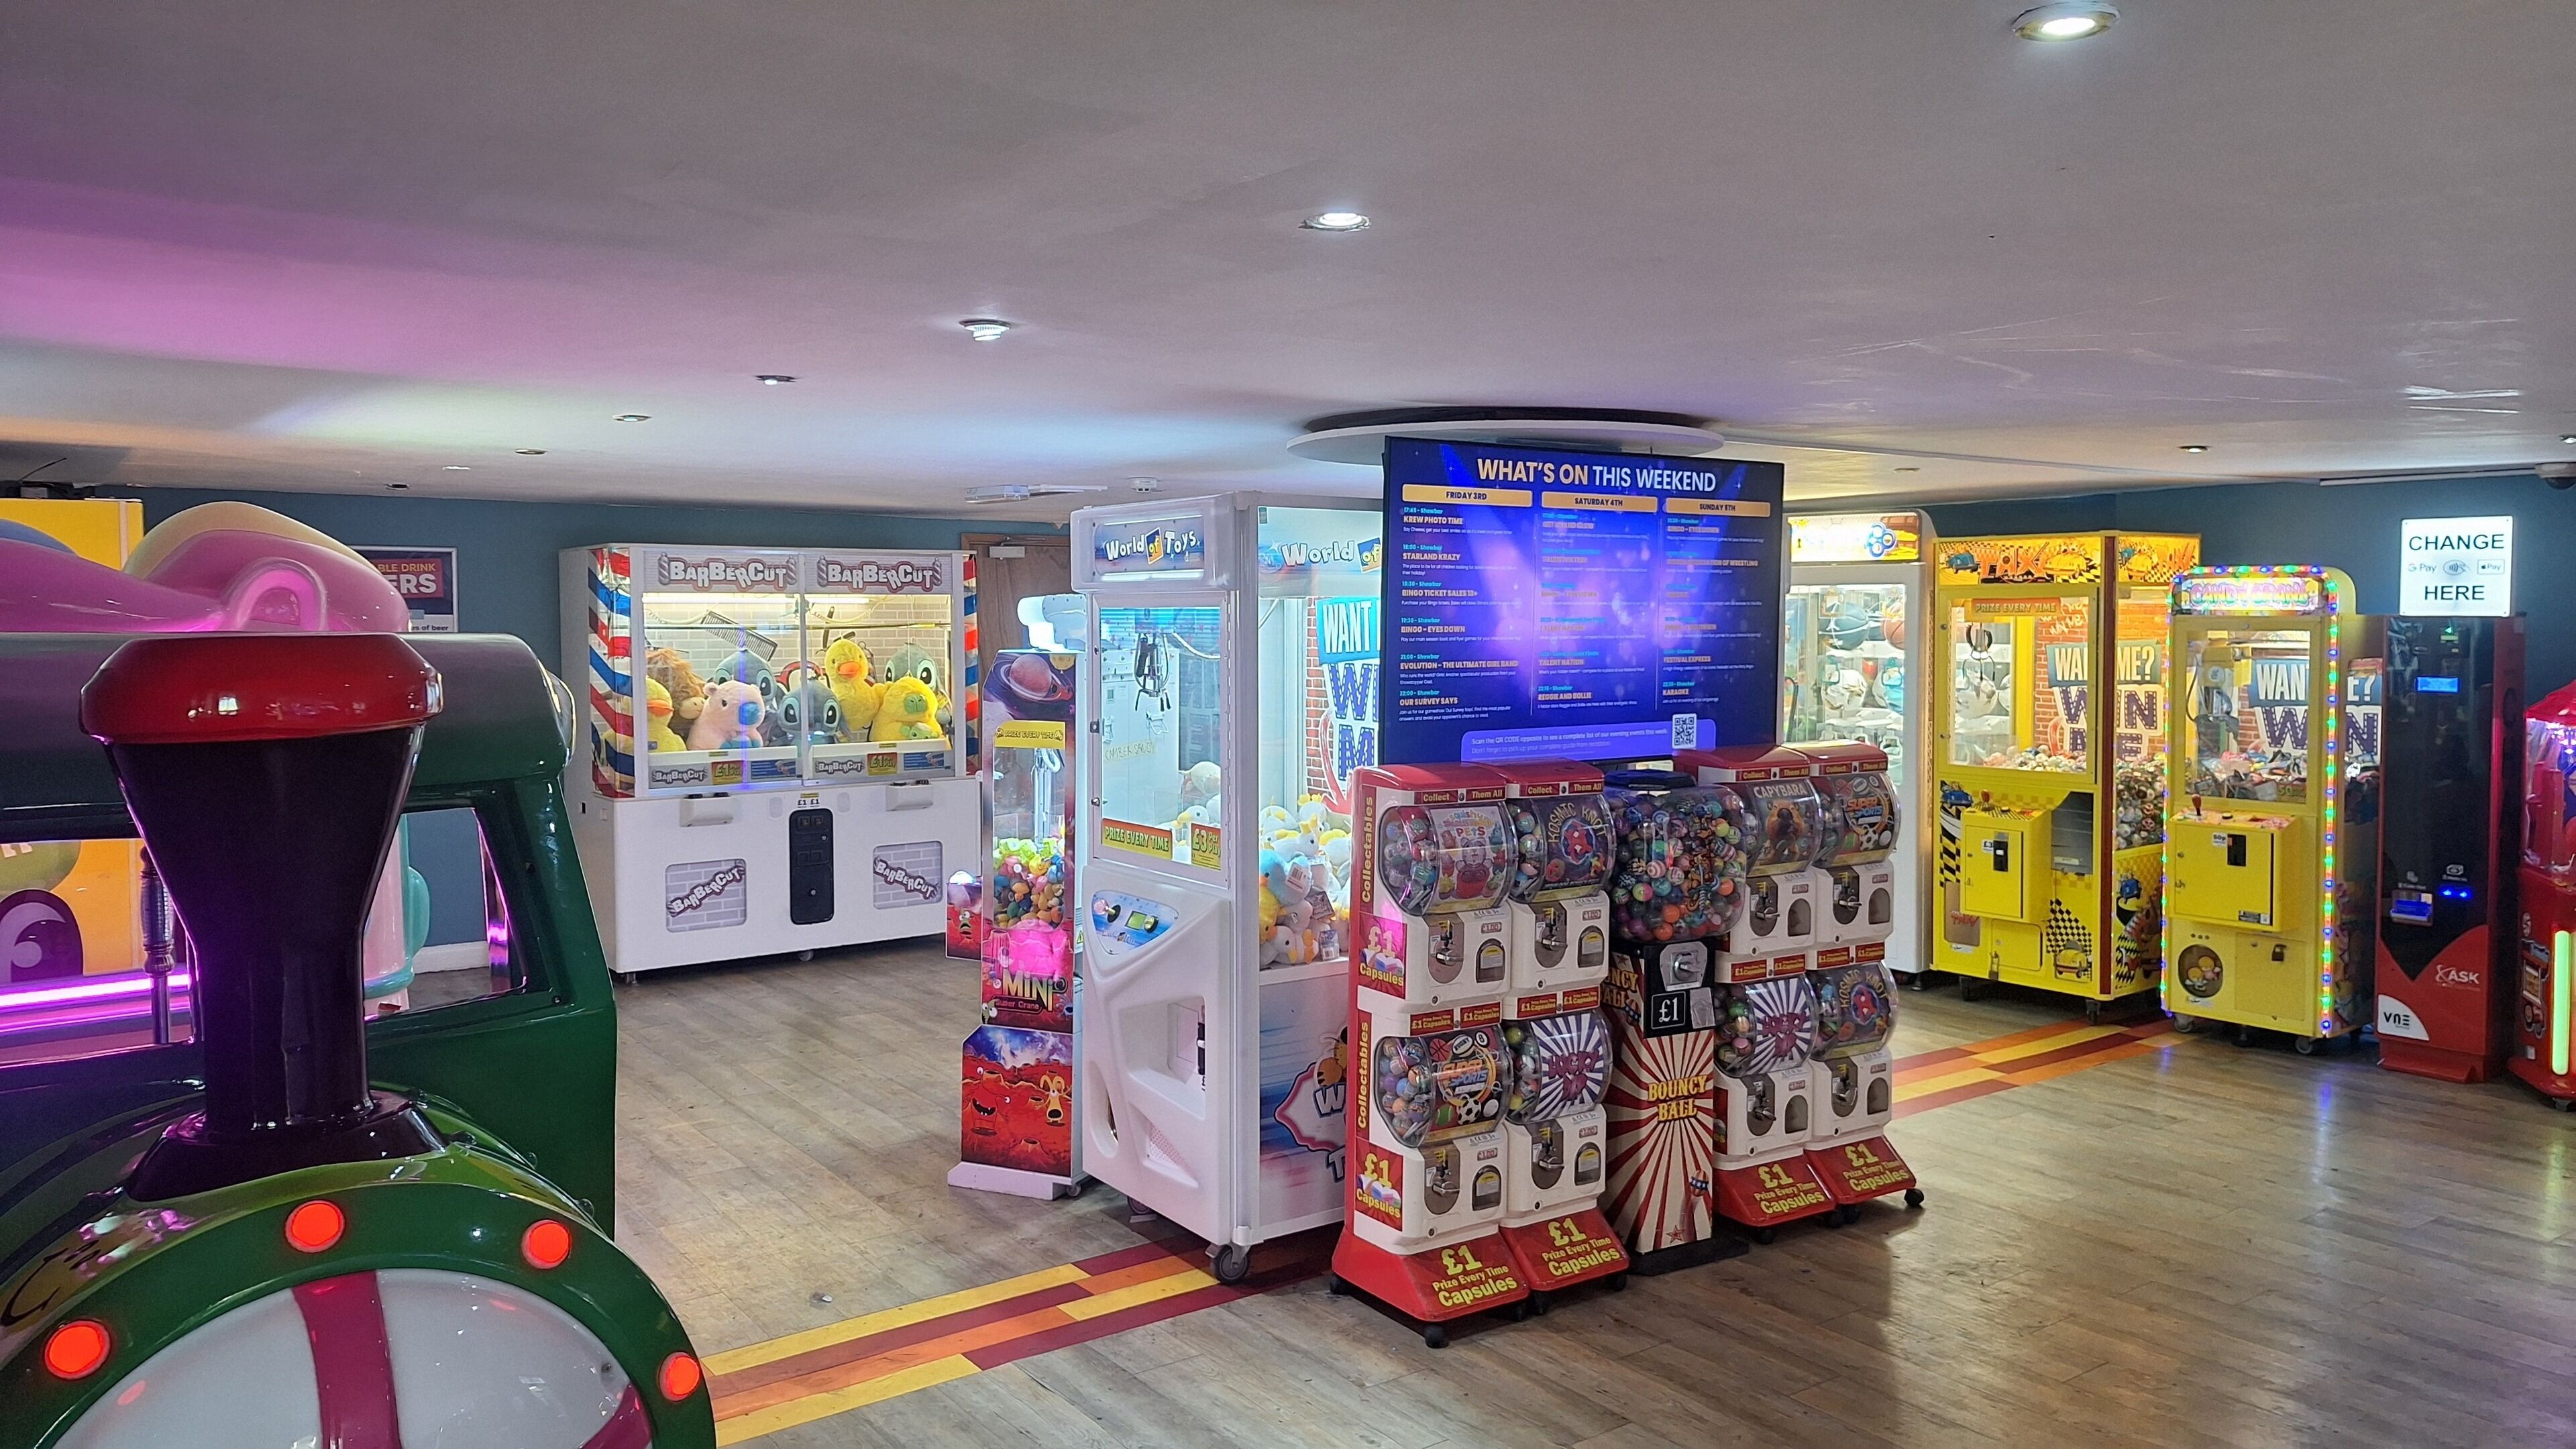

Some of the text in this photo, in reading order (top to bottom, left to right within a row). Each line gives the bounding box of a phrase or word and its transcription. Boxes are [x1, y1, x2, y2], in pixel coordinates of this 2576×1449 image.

[1477, 458, 1716, 492] WHAT'S ON THIS WEEKEND
[1446, 491, 1488, 501] FRIDAY 3RD
[1574, 498, 1623, 506] SATURDAY 4TH
[1699, 503, 1723, 511] SUNDAY
[1106, 530, 1197, 561] World of Toys
[1280, 540, 1355, 567] World
[2409, 534, 2504, 551] CHANGE
[401, 563, 436, 572] DRINK
[2420, 563, 2437, 574] Pay
[2487, 563, 2502, 571] Pay
[2424, 585, 2485, 600] HERE
[1975, 602, 2057, 613] PRIZE EVERY TIME
[1322, 600, 1373, 655] WANT
[2256, 663, 2309, 700] WAN
[1743, 771, 1765, 780] Collect
[1423, 789, 1503, 804] Collect Them All
[1527, 782, 1603, 796] Collect Them All
[1753, 783, 1807, 799] CAPYBARA
[1547, 802, 1608, 843] KOSMIC KNOT
[1104, 826, 1170, 852] PRIZE EVERY TIME
[1192, 828, 1219, 853] £3 Per
[1361, 796, 1373, 903] Collectables
[1367, 926, 1395, 958] £1
[1359, 962, 1404, 986] Capsules
[1462, 1011, 1500, 1022] £1 Capsules
[1658, 997, 1679, 1023] £1
[1411, 1018, 1451, 1029] £1 Capsules
[1478, 1034, 1485, 1043] 8
[1357, 1020, 1369, 1128] Collectables
[1448, 1070, 1489, 1087] SPORTS
[1648, 1075, 1707, 1102] BOUNCY
[1657, 1098, 1698, 1122] BALL
[1845, 1142, 1880, 1167] £1
[1364, 1152, 1392, 1188] £1
[1758, 1163, 1794, 1189] £1
[1842, 1169, 1864, 1180] Prize
[1862, 1163, 1884, 1175] Every
[1848, 1168, 1910, 1191] Capsules
[1356, 1187, 1401, 1219] Capsules
[1754, 1181, 1817, 1201] Prize Every Time
[1760, 1190, 1825, 1214] Capsules
[1548, 1218, 1587, 1247] £1
[1441, 1244, 1483, 1276] £1
[1542, 1236, 1612, 1263] Prize Every Time
[1548, 1246, 1621, 1277] Capsules
[1432, 1265, 1509, 1292] Prize Every Time
[1438, 1275, 1518, 1307] Capsules
